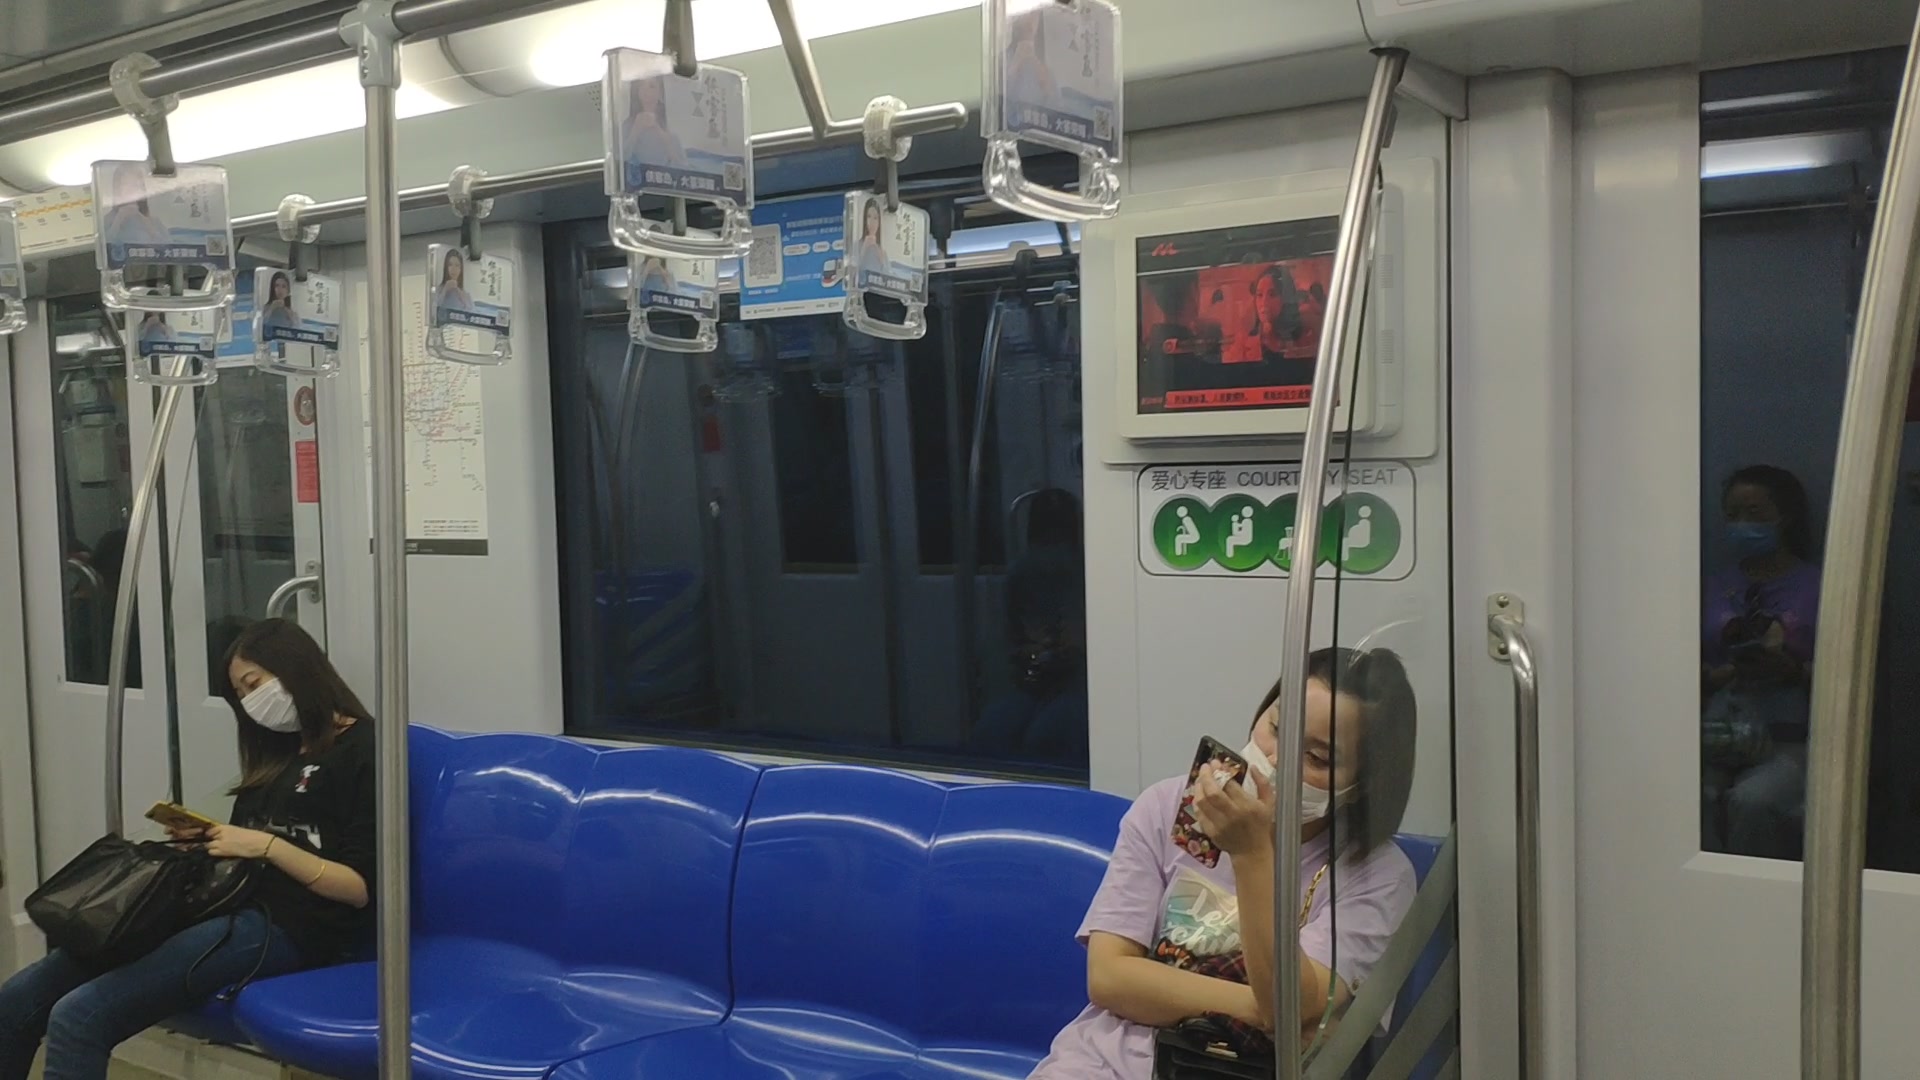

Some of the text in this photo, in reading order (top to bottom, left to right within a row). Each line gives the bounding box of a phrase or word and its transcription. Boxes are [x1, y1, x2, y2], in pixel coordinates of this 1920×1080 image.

[1151, 468, 1397, 491] 爱心专座 COURTY SEAT
